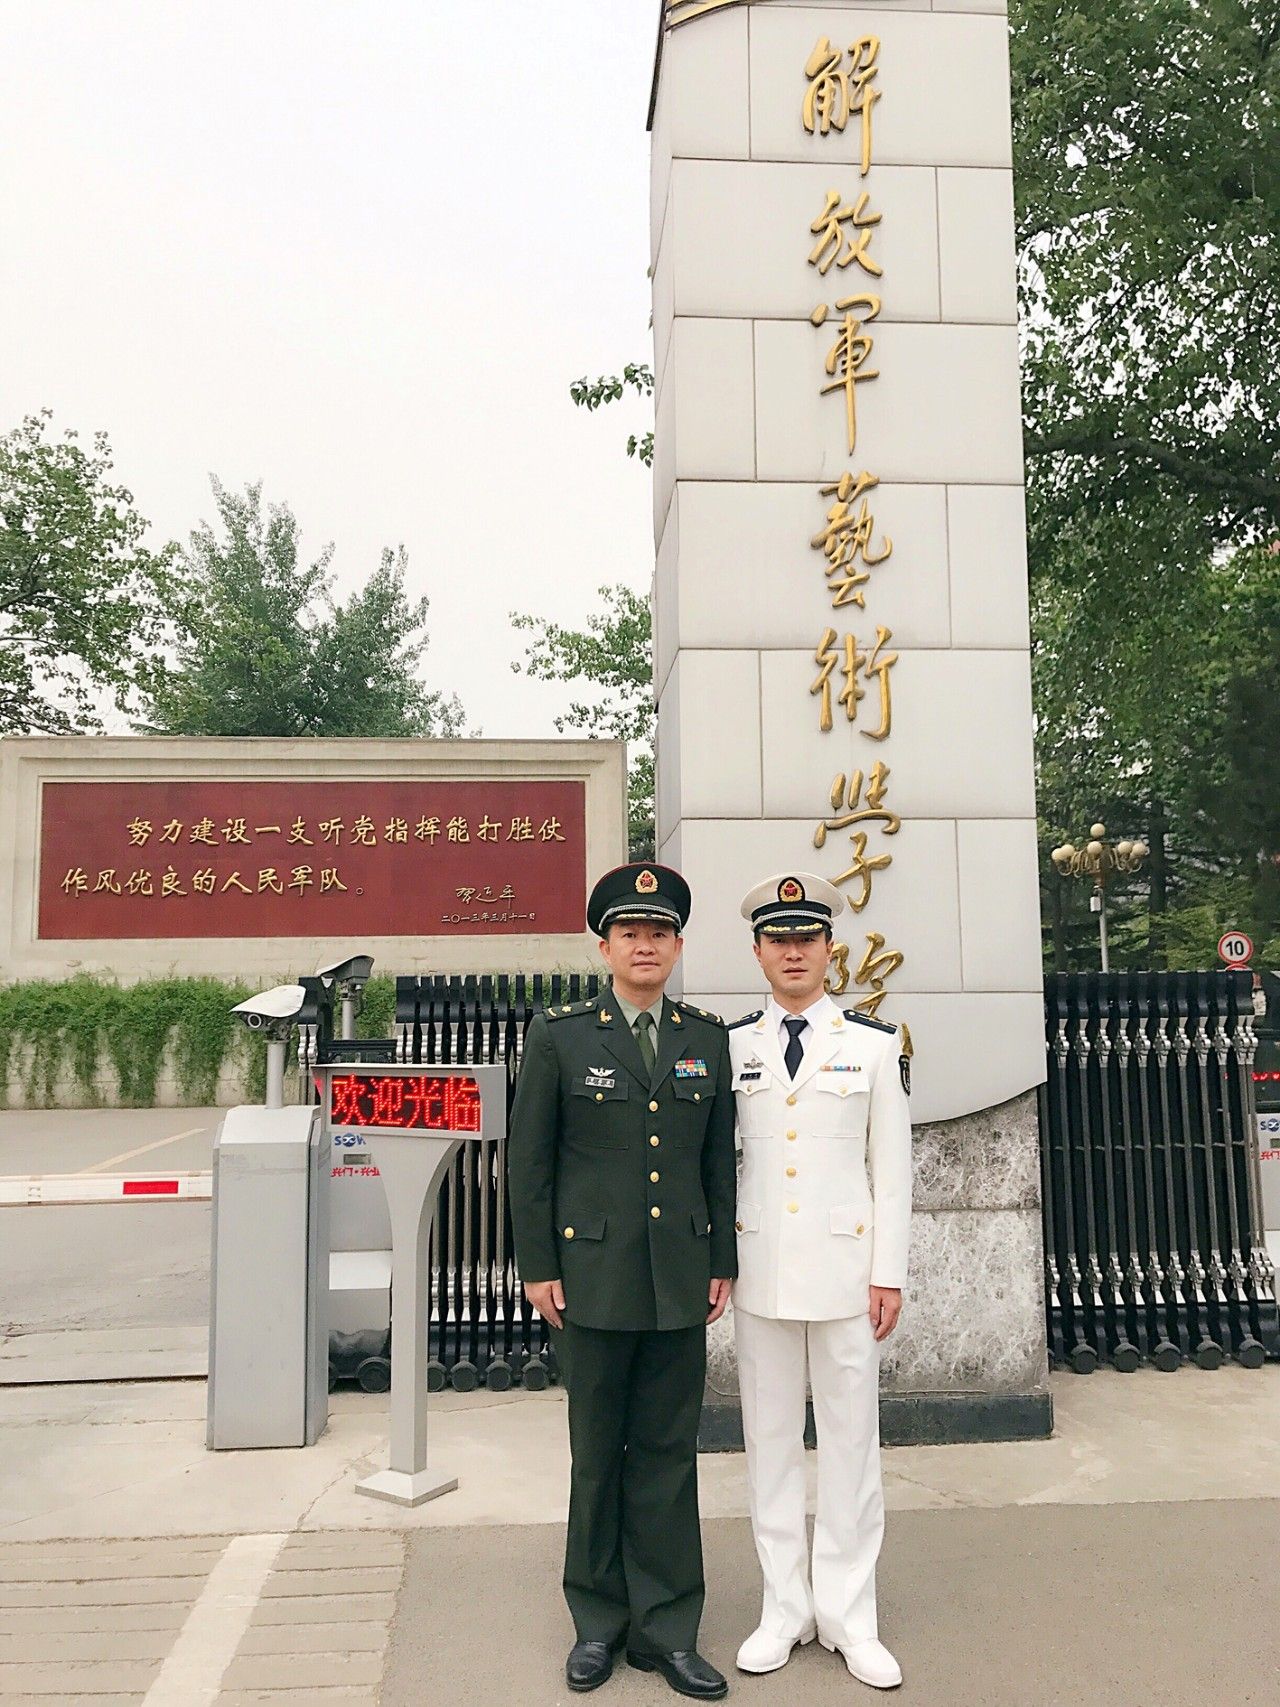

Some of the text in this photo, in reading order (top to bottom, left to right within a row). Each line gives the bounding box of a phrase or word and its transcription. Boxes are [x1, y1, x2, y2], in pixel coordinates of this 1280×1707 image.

[126, 815, 567, 847] 努力建设一支听党指挥能打胜仗
[60, 864, 364, 898] 作风优良的人民军队。
[1226, 940, 1244, 956] 10
[331, 1074, 481, 1131] 欢迎光临
